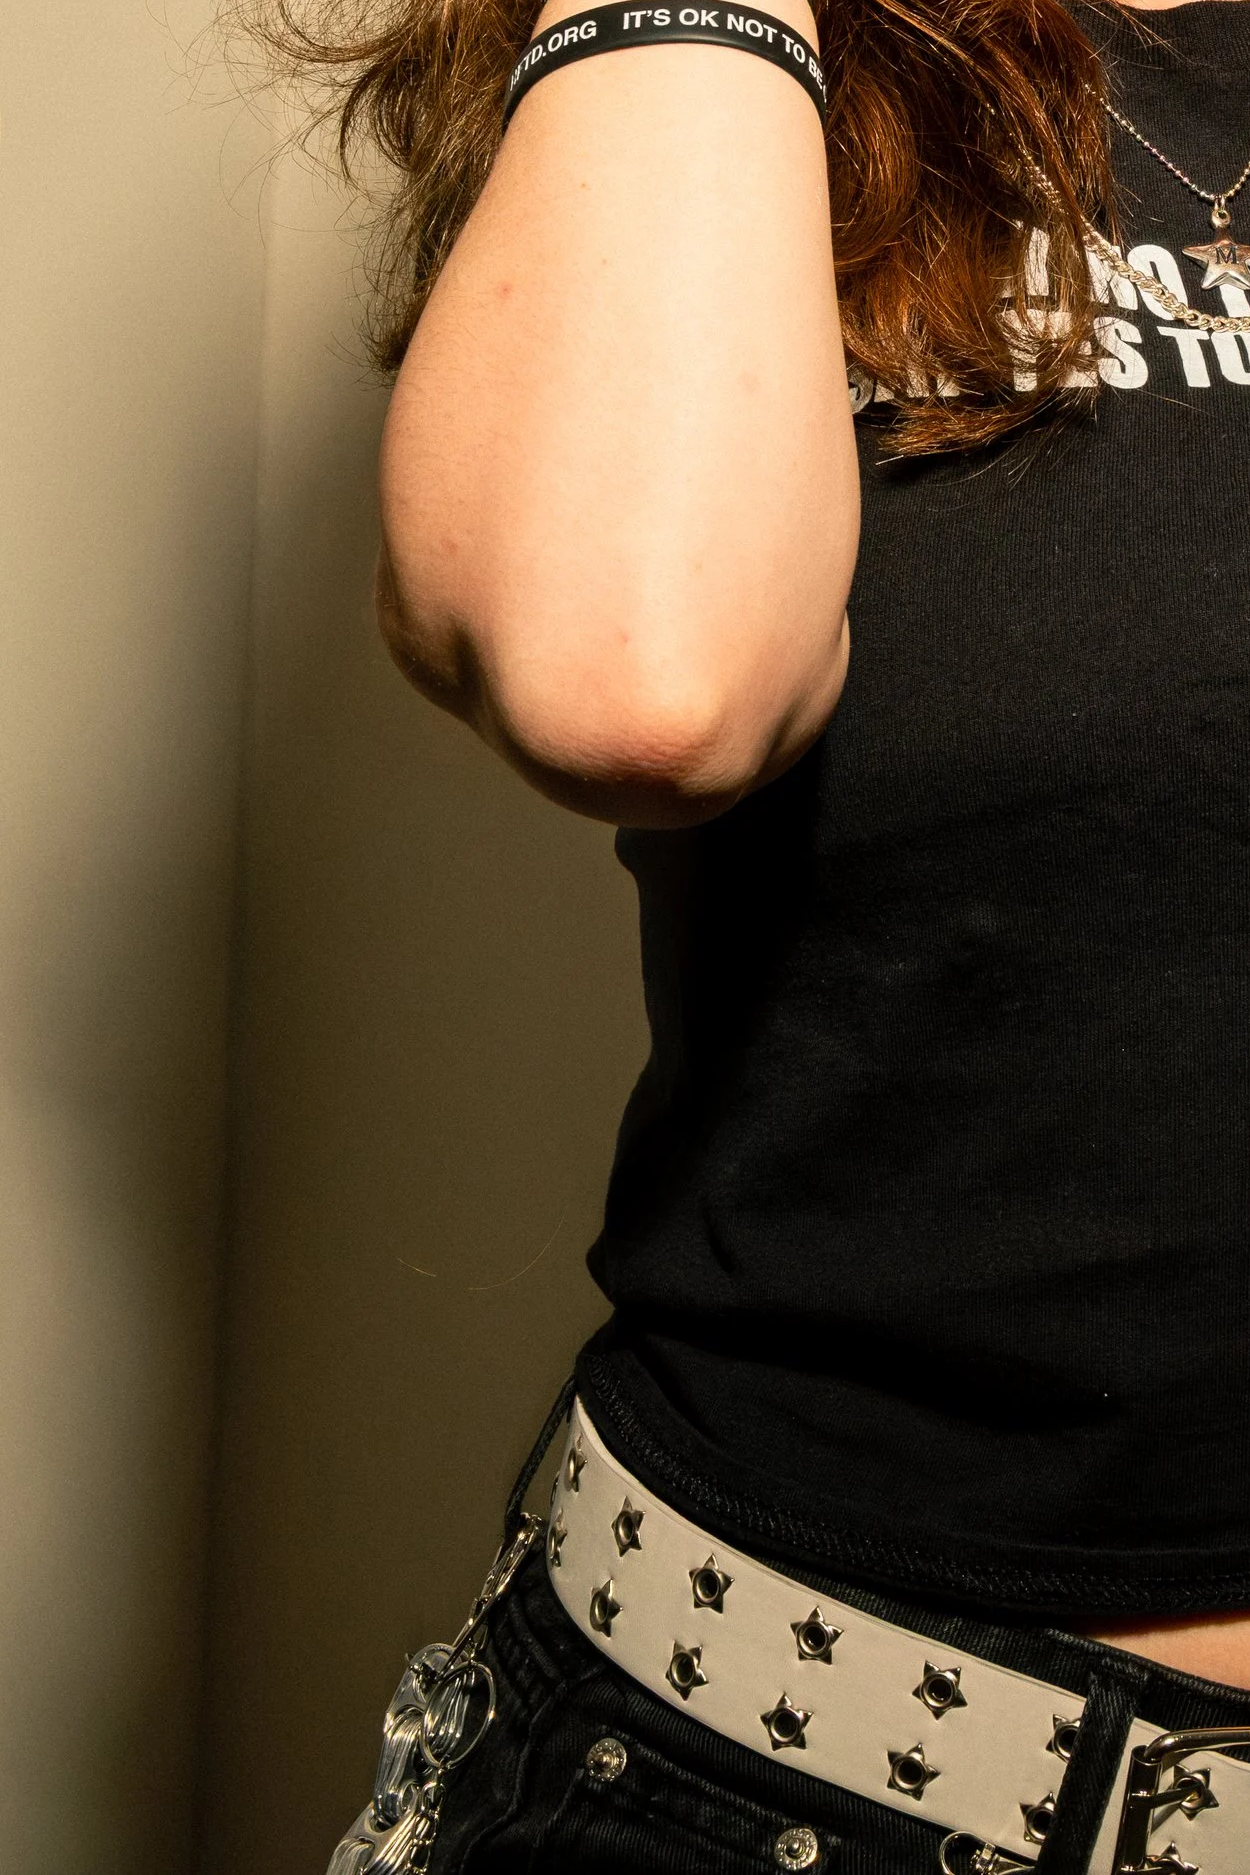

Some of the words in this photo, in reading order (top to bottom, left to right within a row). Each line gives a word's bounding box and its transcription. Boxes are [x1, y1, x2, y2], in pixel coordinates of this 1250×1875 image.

[623, 7, 671, 30] IT'S
[679, 8, 720, 28] OK
[727, 13, 778, 44] NOT
[782, 33, 806, 64] TO
[808, 56, 823, 90] BE
[1215, 246, 1238, 266] M
